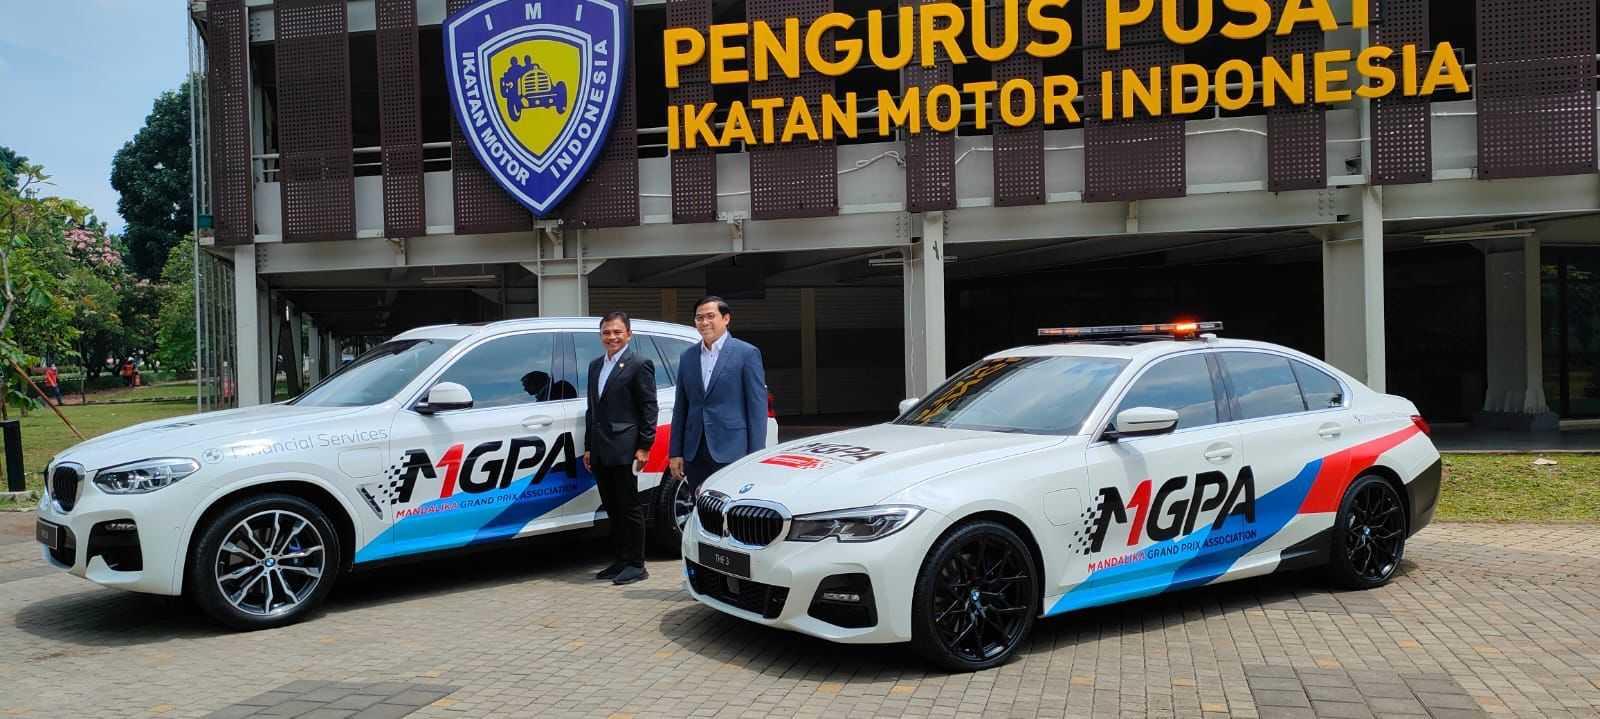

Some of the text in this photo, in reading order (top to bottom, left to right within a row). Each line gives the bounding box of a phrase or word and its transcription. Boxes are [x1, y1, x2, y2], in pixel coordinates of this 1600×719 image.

[664, 0, 1073, 89] PENGURUS
[462, 51, 530, 187] IKATAN MOTOR
[549, 39, 608, 179] INDONESIA
[667, 40, 1471, 151] IKATAN MOTOR INDONESIA
[231, 427, 389, 459] Fancial Services
[396, 502, 459, 519] MANDALIKA
[459, 496, 495, 510] GRAND
[496, 493, 520, 504] PRIX
[1087, 529, 1258, 572] MANDALIKA GRAND PRIX ASSOCIATION
